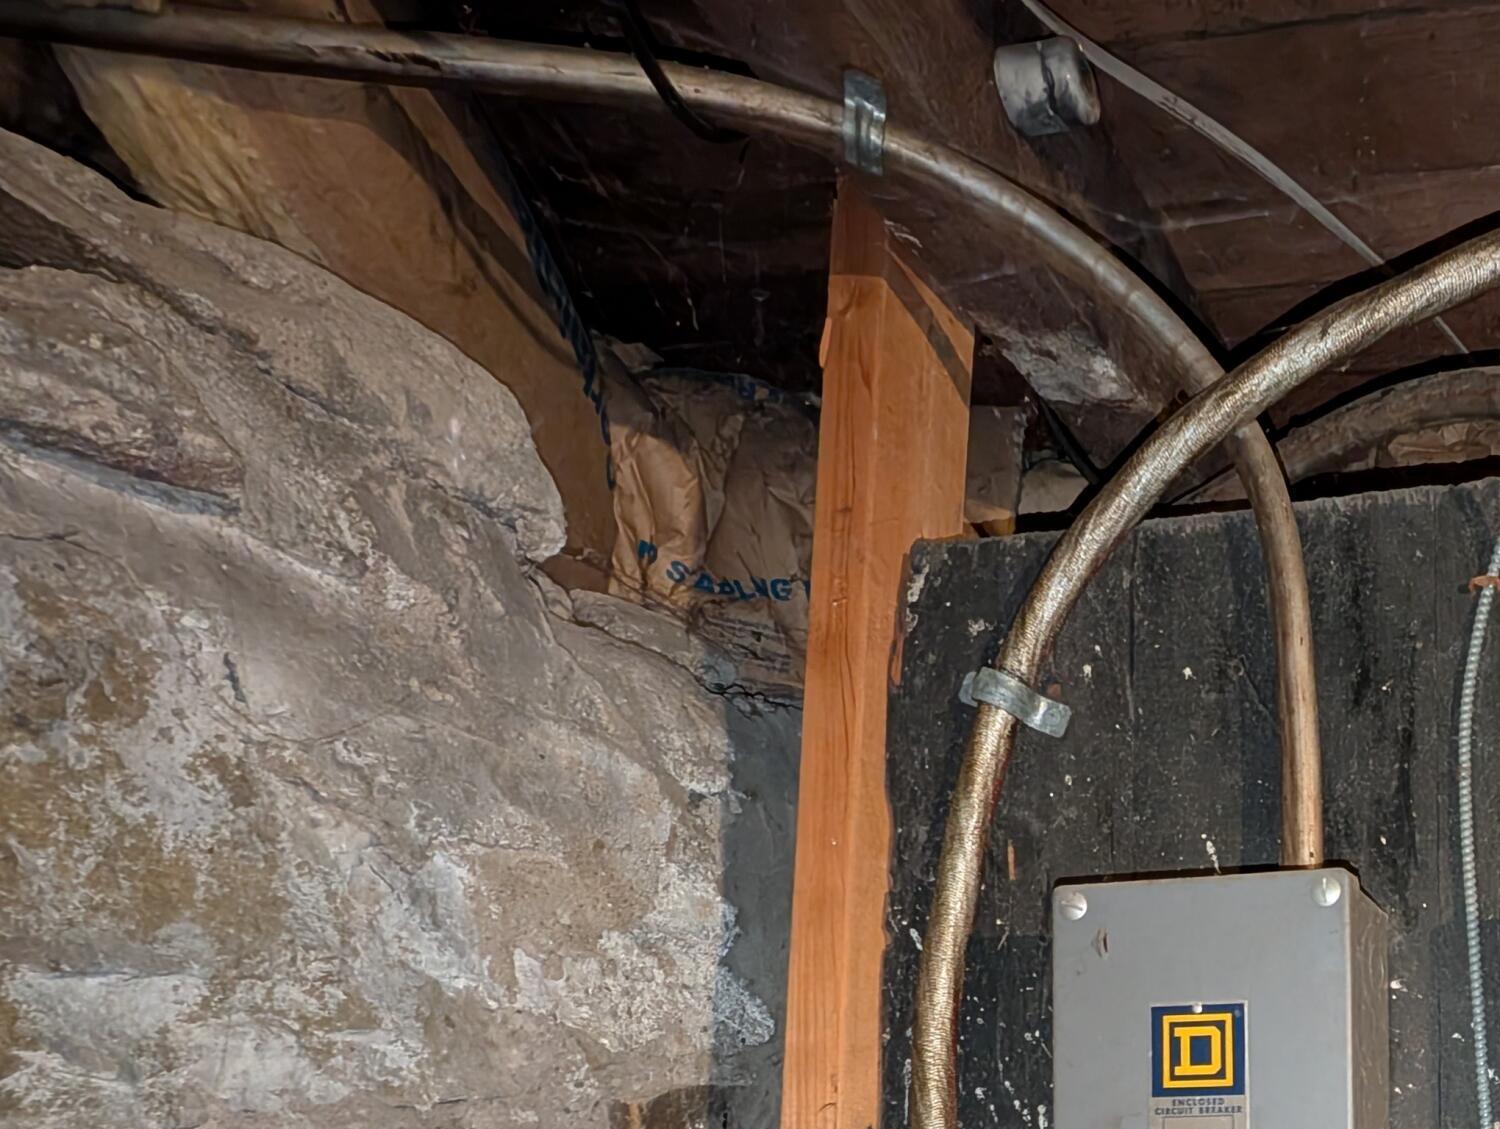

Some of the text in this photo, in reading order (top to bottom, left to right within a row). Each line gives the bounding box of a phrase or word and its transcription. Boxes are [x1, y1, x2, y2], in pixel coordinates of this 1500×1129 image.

[1172, 1097, 1225, 1106] ENCLOSED
[1155, 1105, 1242, 1115] CIRCUIT BREAKER
